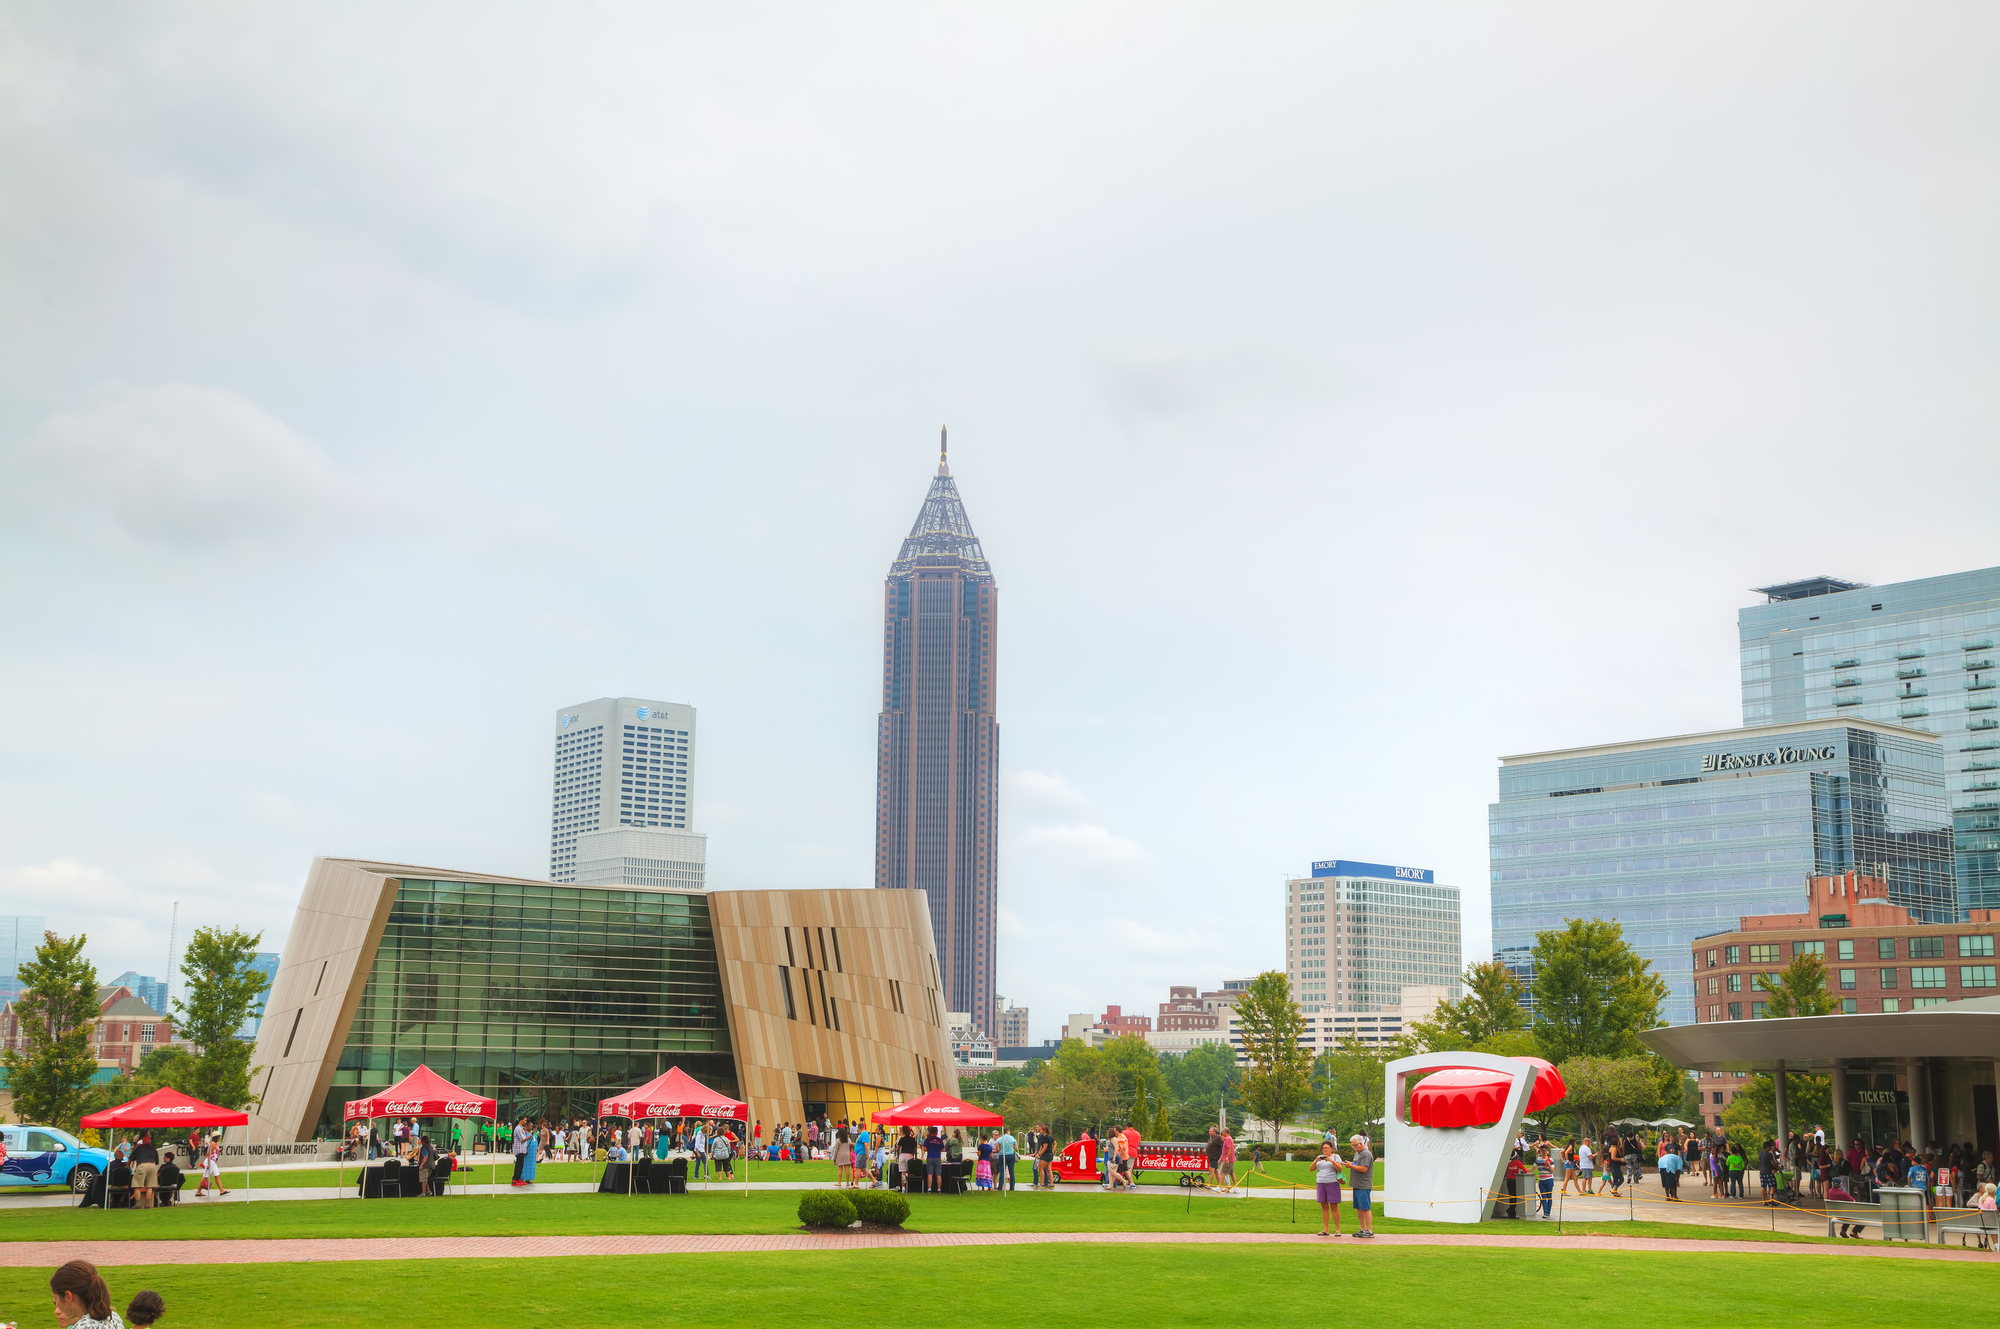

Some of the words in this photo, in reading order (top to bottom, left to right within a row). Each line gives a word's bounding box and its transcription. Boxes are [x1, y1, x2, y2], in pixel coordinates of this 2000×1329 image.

[652, 711, 669, 720] at&t
[1314, 861, 1337, 870] EMORY
[1395, 866, 1425, 880] EMORY
[1858, 1090, 1896, 1103] TICKETS
[150, 1106, 196, 1114] Coca-Cola
[385, 1100, 424, 1114] Coca-Cola
[445, 1101, 483, 1114] Coca-Cola
[646, 1104, 682, 1116] Coca-Cola
[701, 1104, 736, 1117] Coca-Cola
[226, 1145, 245, 1156] CIVIL
[248, 1145, 263, 1155] AND
[265, 1144, 291, 1155] HUMAN
[293, 1144, 318, 1155] RIGHTS
[1142, 1157, 1169, 1167] Coca-Cola
[1175, 1158, 1203, 1168] Coca-Cola
